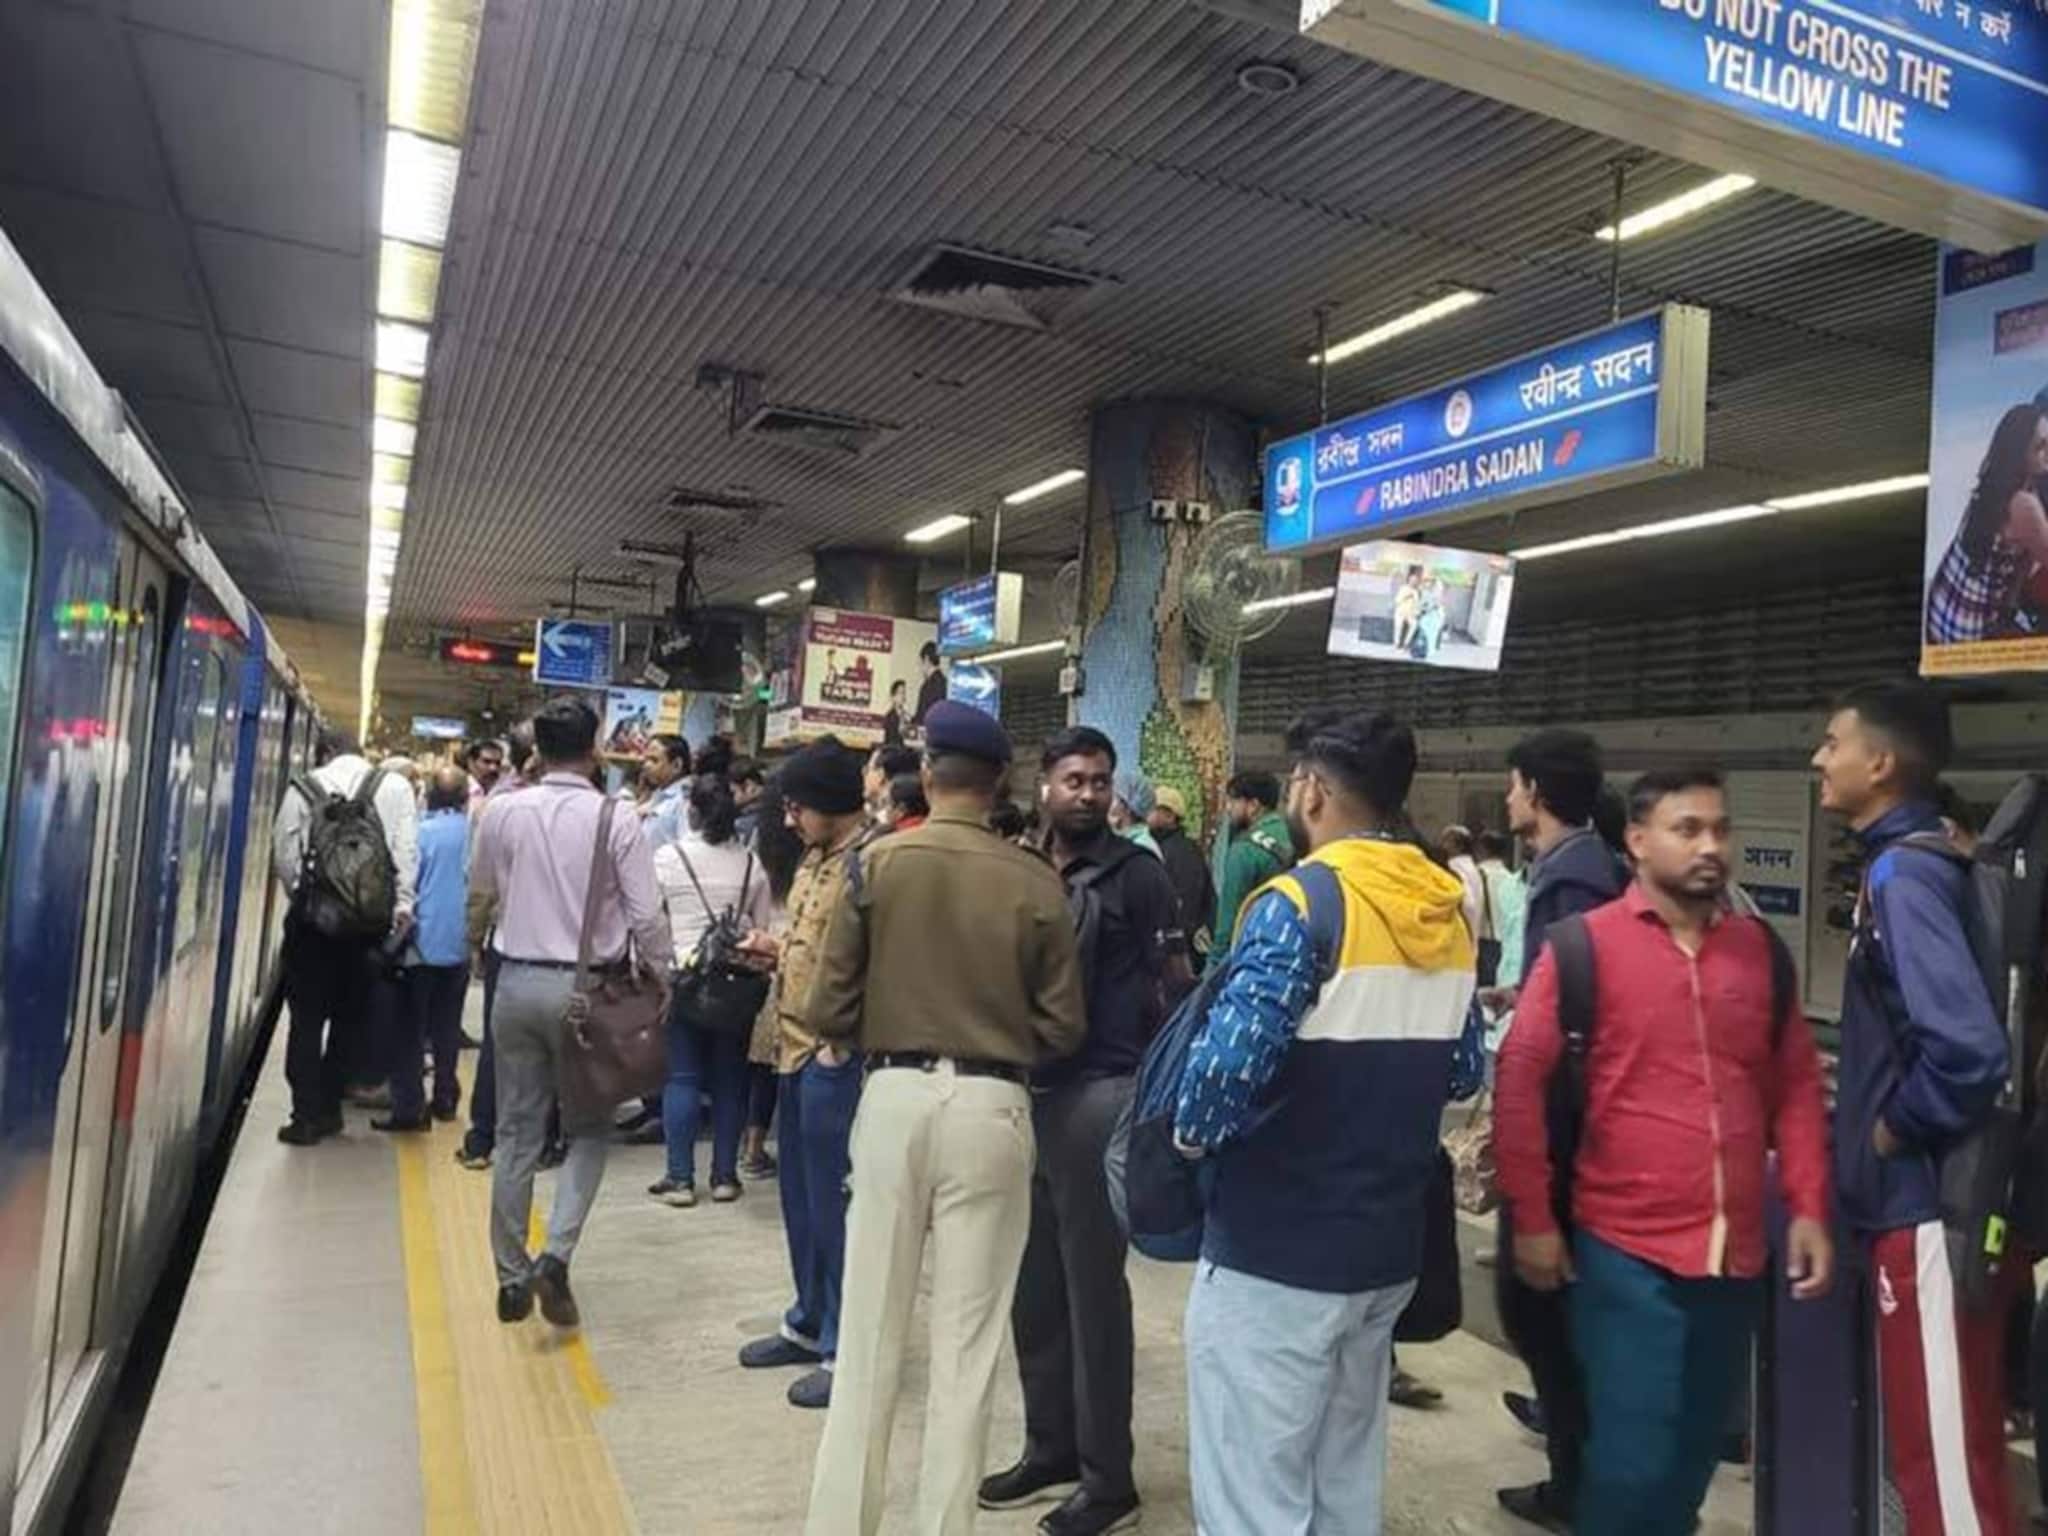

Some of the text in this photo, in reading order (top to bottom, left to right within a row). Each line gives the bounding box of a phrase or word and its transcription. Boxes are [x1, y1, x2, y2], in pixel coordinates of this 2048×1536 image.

[1955, 2, 1972, 29] न
[1715, 0, 1782, 45] NOT
[1786, 10, 1889, 86] CROSS
[1897, 49, 1952, 109] THE
[1704, 36, 1906, 147] YELLOW LINE
[1519, 341, 1655, 411] रवीन्द्र सदन
[1379, 438, 1544, 511] RABINDRA SADAN
